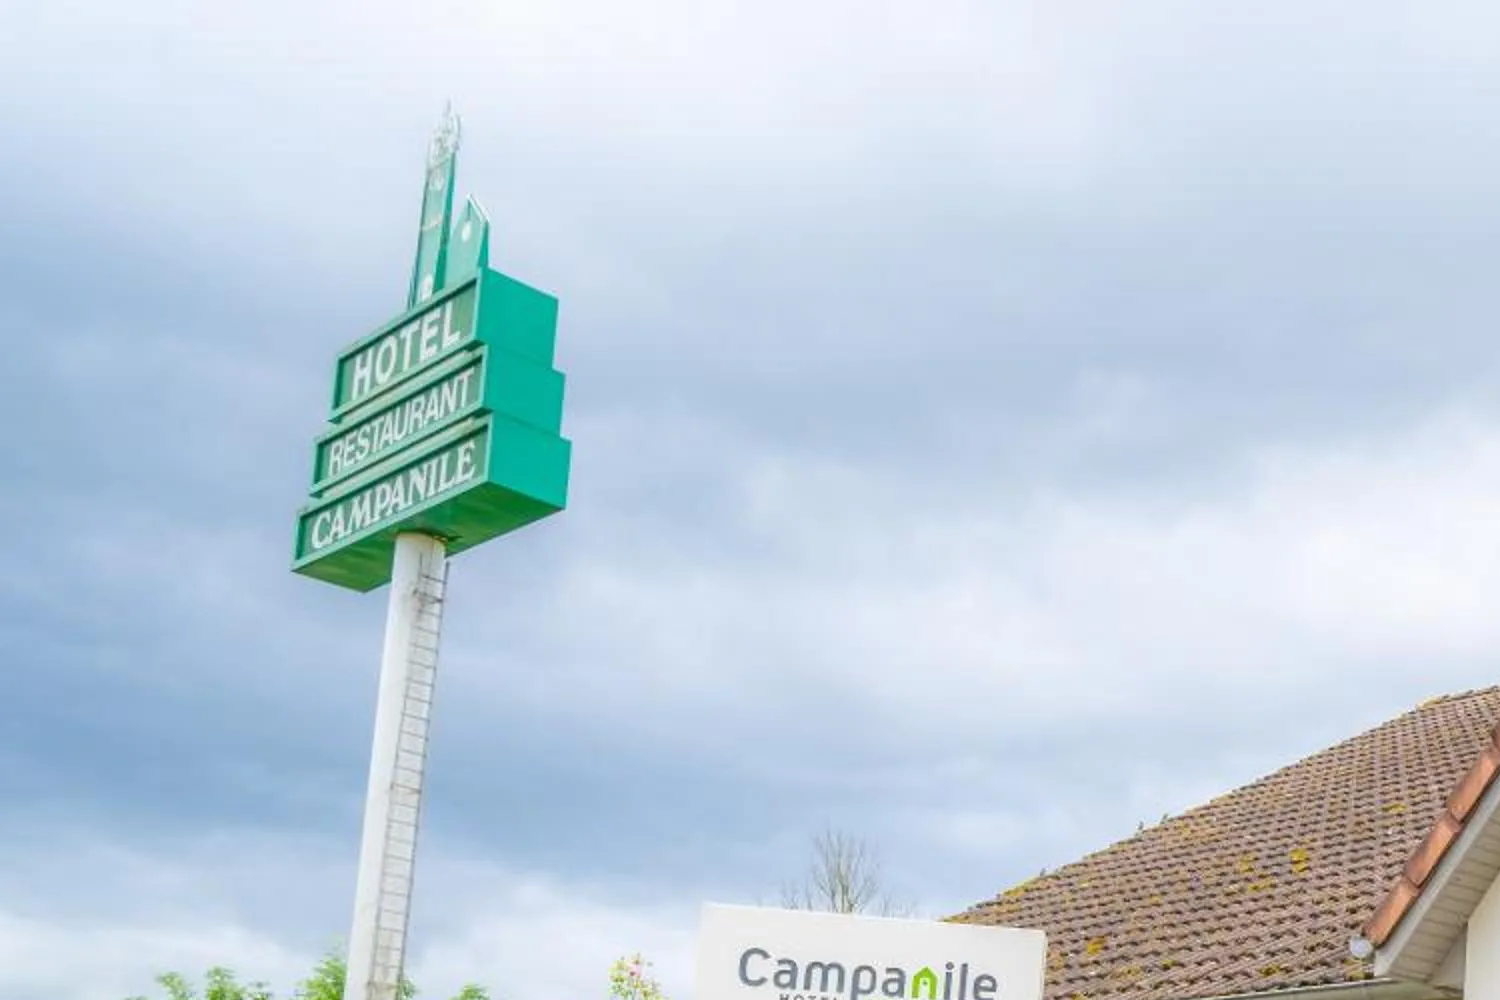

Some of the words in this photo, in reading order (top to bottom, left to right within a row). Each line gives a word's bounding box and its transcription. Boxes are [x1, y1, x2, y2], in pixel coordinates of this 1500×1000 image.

[350, 302, 461, 401] HOTEL
[329, 367, 474, 478] RESTAURANT
[312, 440, 475, 549] CAMPANILE
